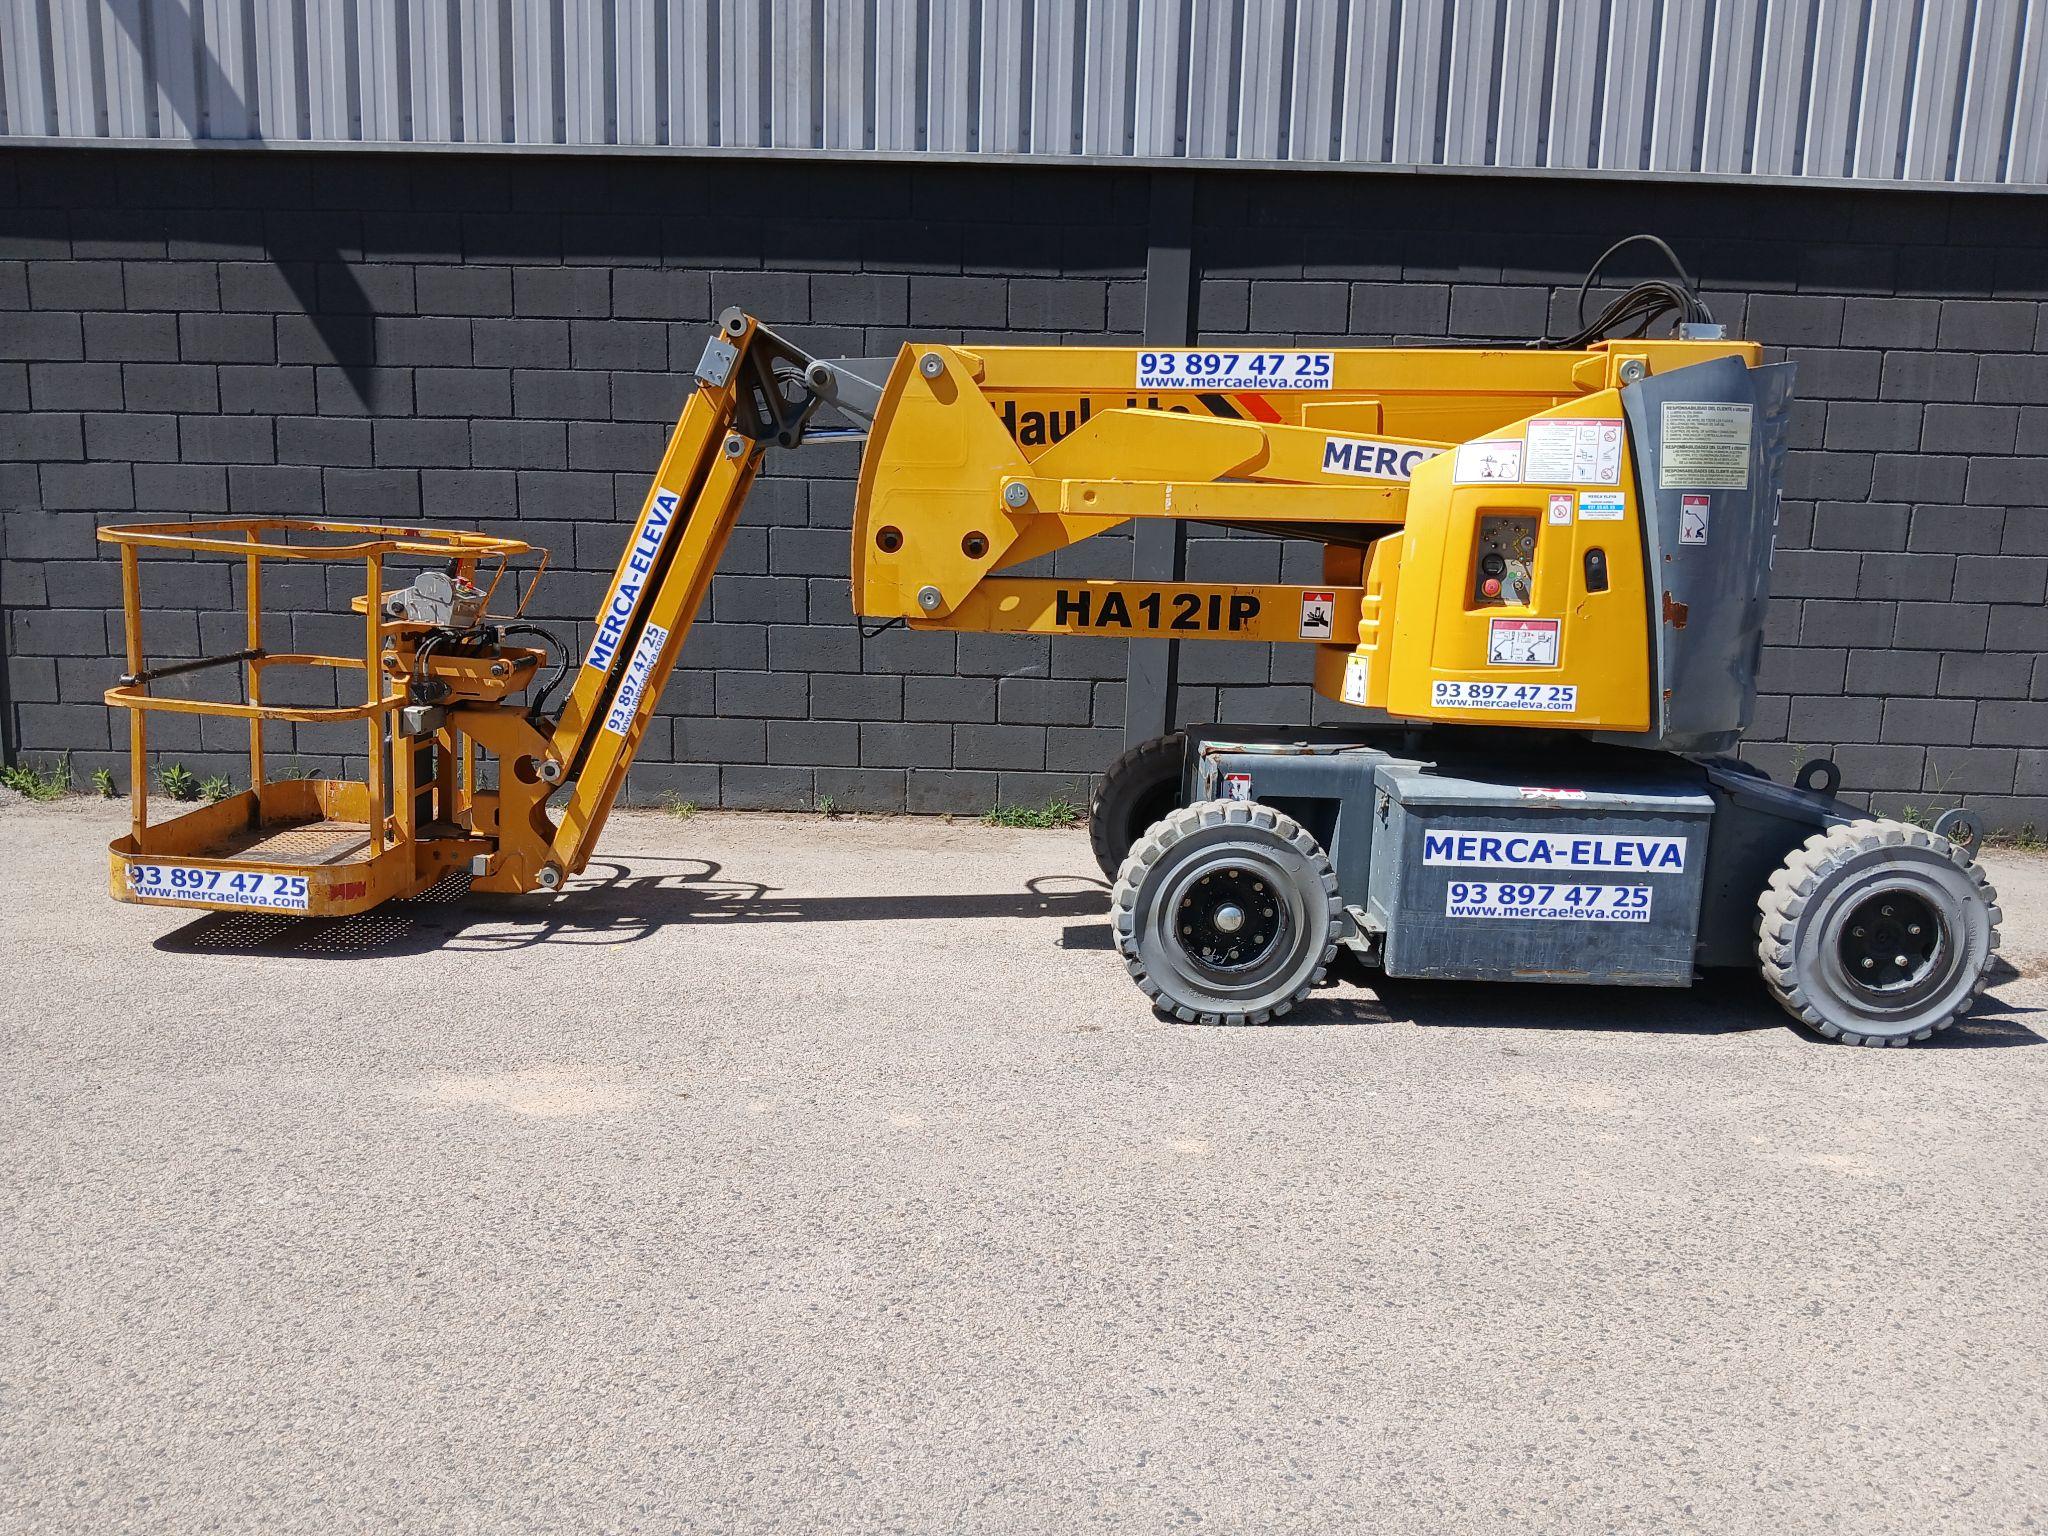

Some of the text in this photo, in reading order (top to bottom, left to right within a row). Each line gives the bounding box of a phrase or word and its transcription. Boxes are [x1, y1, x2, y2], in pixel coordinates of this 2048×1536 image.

[1141, 353, 1330, 376] 93 897 47 25
[1140, 375, 1329, 389] www.mercaeleva.com
[1323, 441, 1441, 478] MERC
[588, 495, 678, 671] MERCA-ELEVA
[1056, 589, 1261, 631] HA12IP
[608, 627, 659, 730] 93 897 47 25
[620, 630, 667, 733] www.mercaeleva.com
[1436, 683, 1574, 701] 93 897 47 25
[1435, 698, 1573, 710] www.mercaeleva.com
[1424, 836, 1683, 868] MERCA-ELEVA
[171, 867, 221, 890] 897
[229, 873, 264, 893] 47
[273, 876, 306, 897] 25
[1451, 883, 1649, 908] 93 897 47 25
[1450, 904, 1647, 920] www.mercaeleva.com
